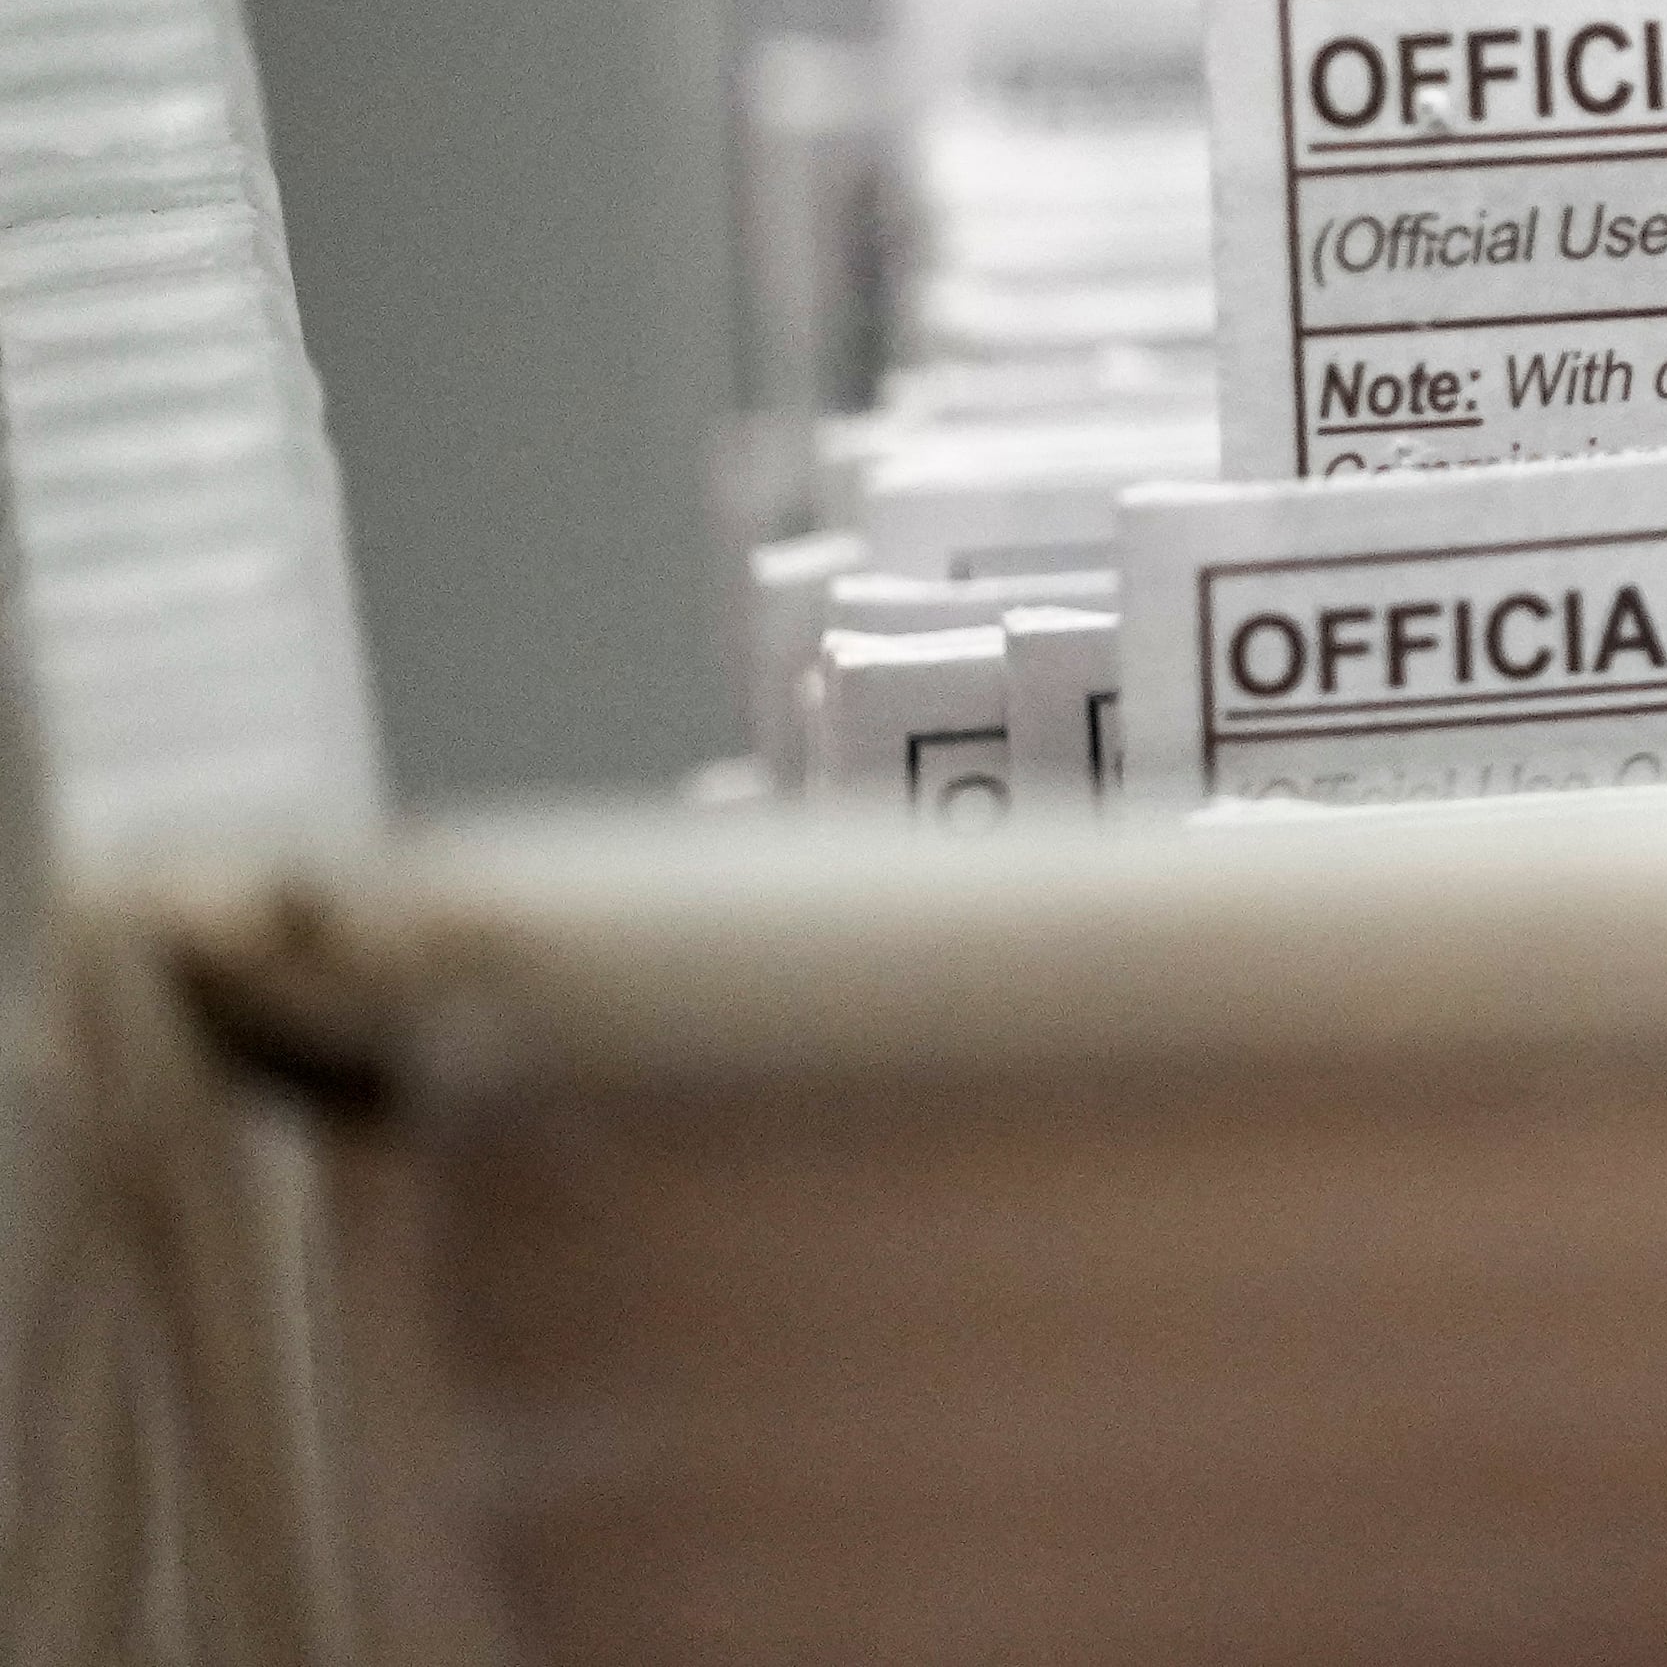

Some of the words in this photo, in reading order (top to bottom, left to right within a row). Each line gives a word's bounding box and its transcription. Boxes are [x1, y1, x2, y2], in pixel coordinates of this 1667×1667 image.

[1312, 205, 1537, 285] (Official
[1320, 363, 1482, 419] Note:
[1505, 350, 1632, 409] With
